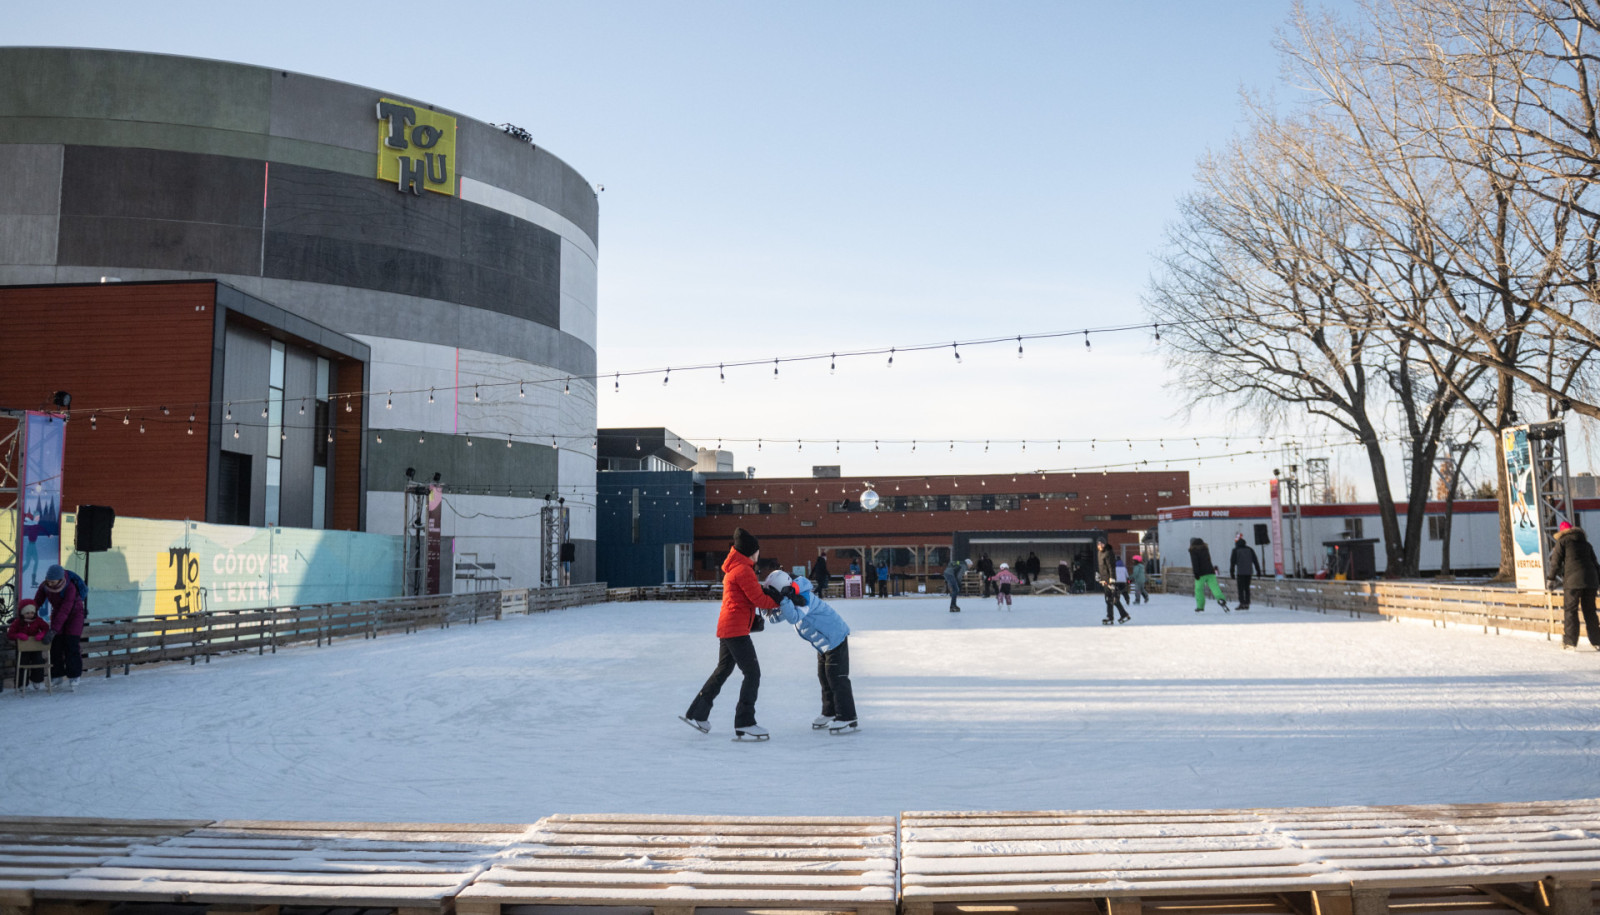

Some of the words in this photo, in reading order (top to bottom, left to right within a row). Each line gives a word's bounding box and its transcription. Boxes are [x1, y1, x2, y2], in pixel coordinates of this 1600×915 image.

[397, 152, 448, 196] HU
[212, 549, 289, 574] CÔTOYER
[1516, 559, 1542, 569] VERTICAL
[212, 581, 280, 603] L'EXTRA
